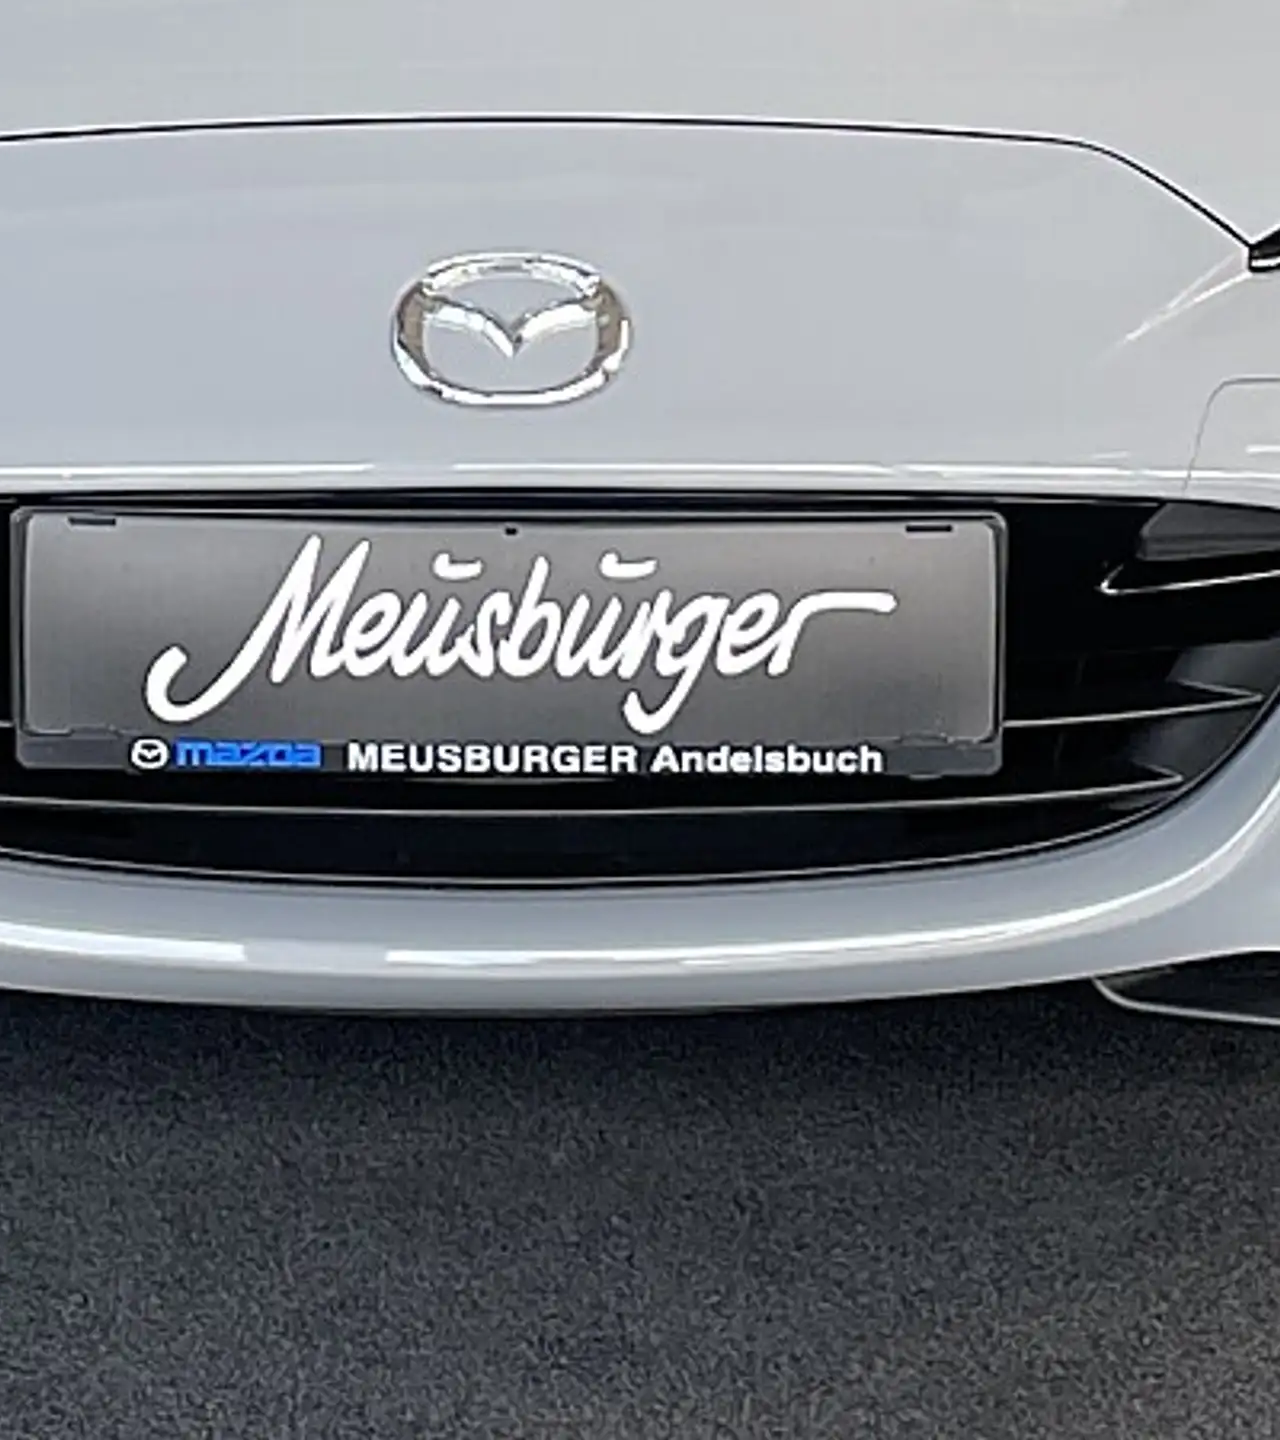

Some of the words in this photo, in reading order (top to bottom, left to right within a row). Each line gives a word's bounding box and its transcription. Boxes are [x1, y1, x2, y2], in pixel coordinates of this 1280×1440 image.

[176, 739, 322, 768] mazda
[347, 742, 638, 773] MEUSBURGER
[650, 743, 884, 774] Andelsbuch
